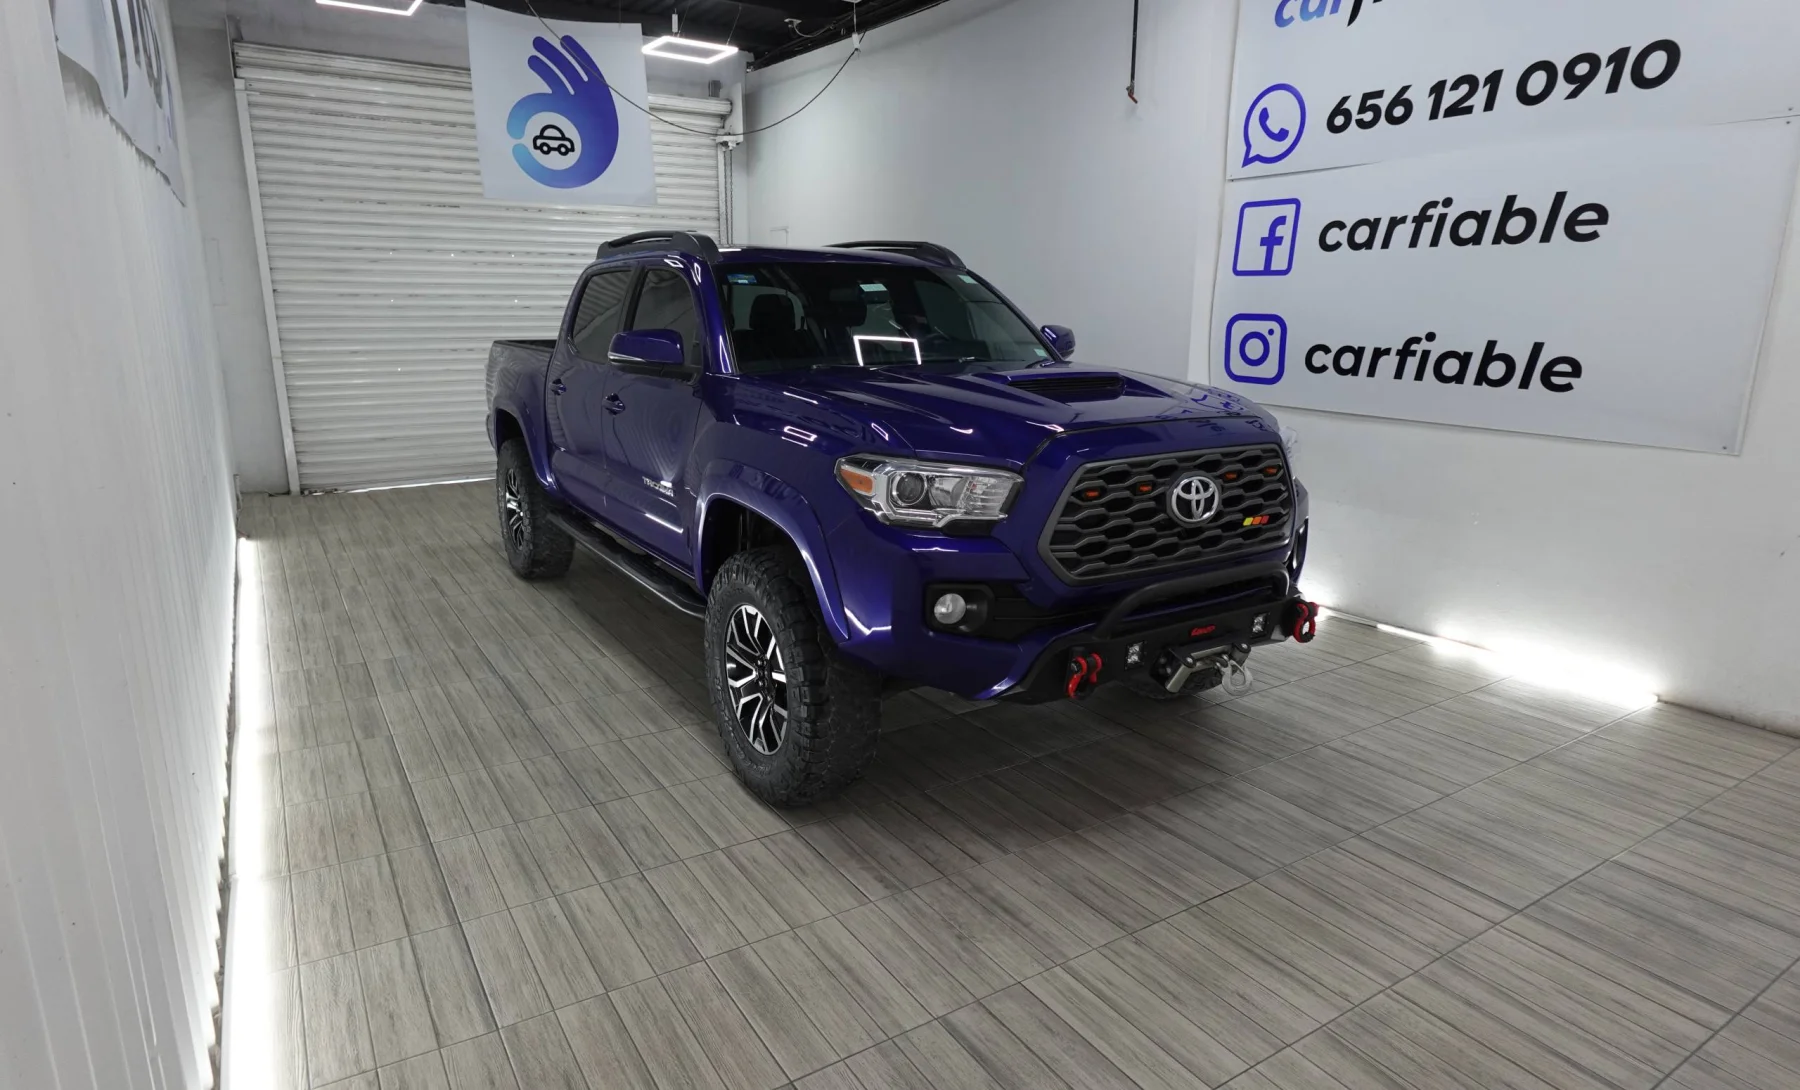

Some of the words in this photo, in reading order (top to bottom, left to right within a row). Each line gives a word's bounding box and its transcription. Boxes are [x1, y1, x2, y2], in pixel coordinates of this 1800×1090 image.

[1325, 84, 1414, 134] 656
[1427, 68, 1505, 121] 121
[1514, 38, 1682, 107] 0910
[1317, 190, 1611, 253] carfiable
[1303, 331, 1584, 394] carfiable
